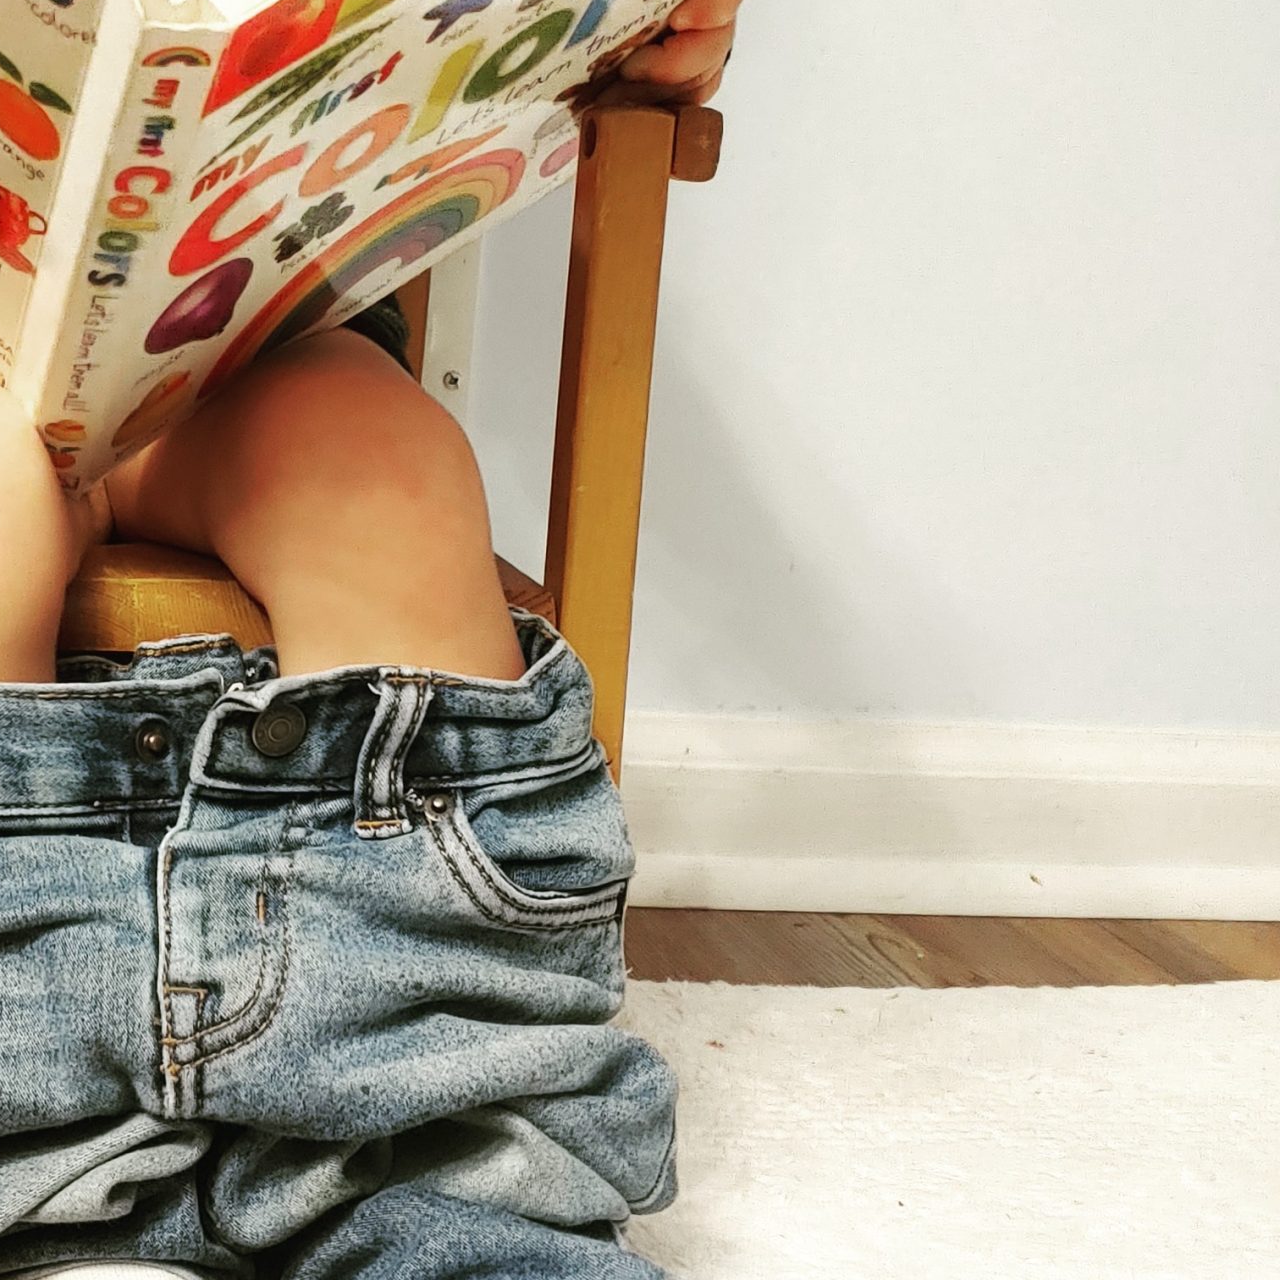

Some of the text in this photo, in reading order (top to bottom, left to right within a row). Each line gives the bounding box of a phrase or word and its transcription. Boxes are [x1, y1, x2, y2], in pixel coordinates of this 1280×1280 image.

[502, 59, 573, 106] learn
[585, 14, 647, 57] them
[87, 165, 173, 289] Colors
